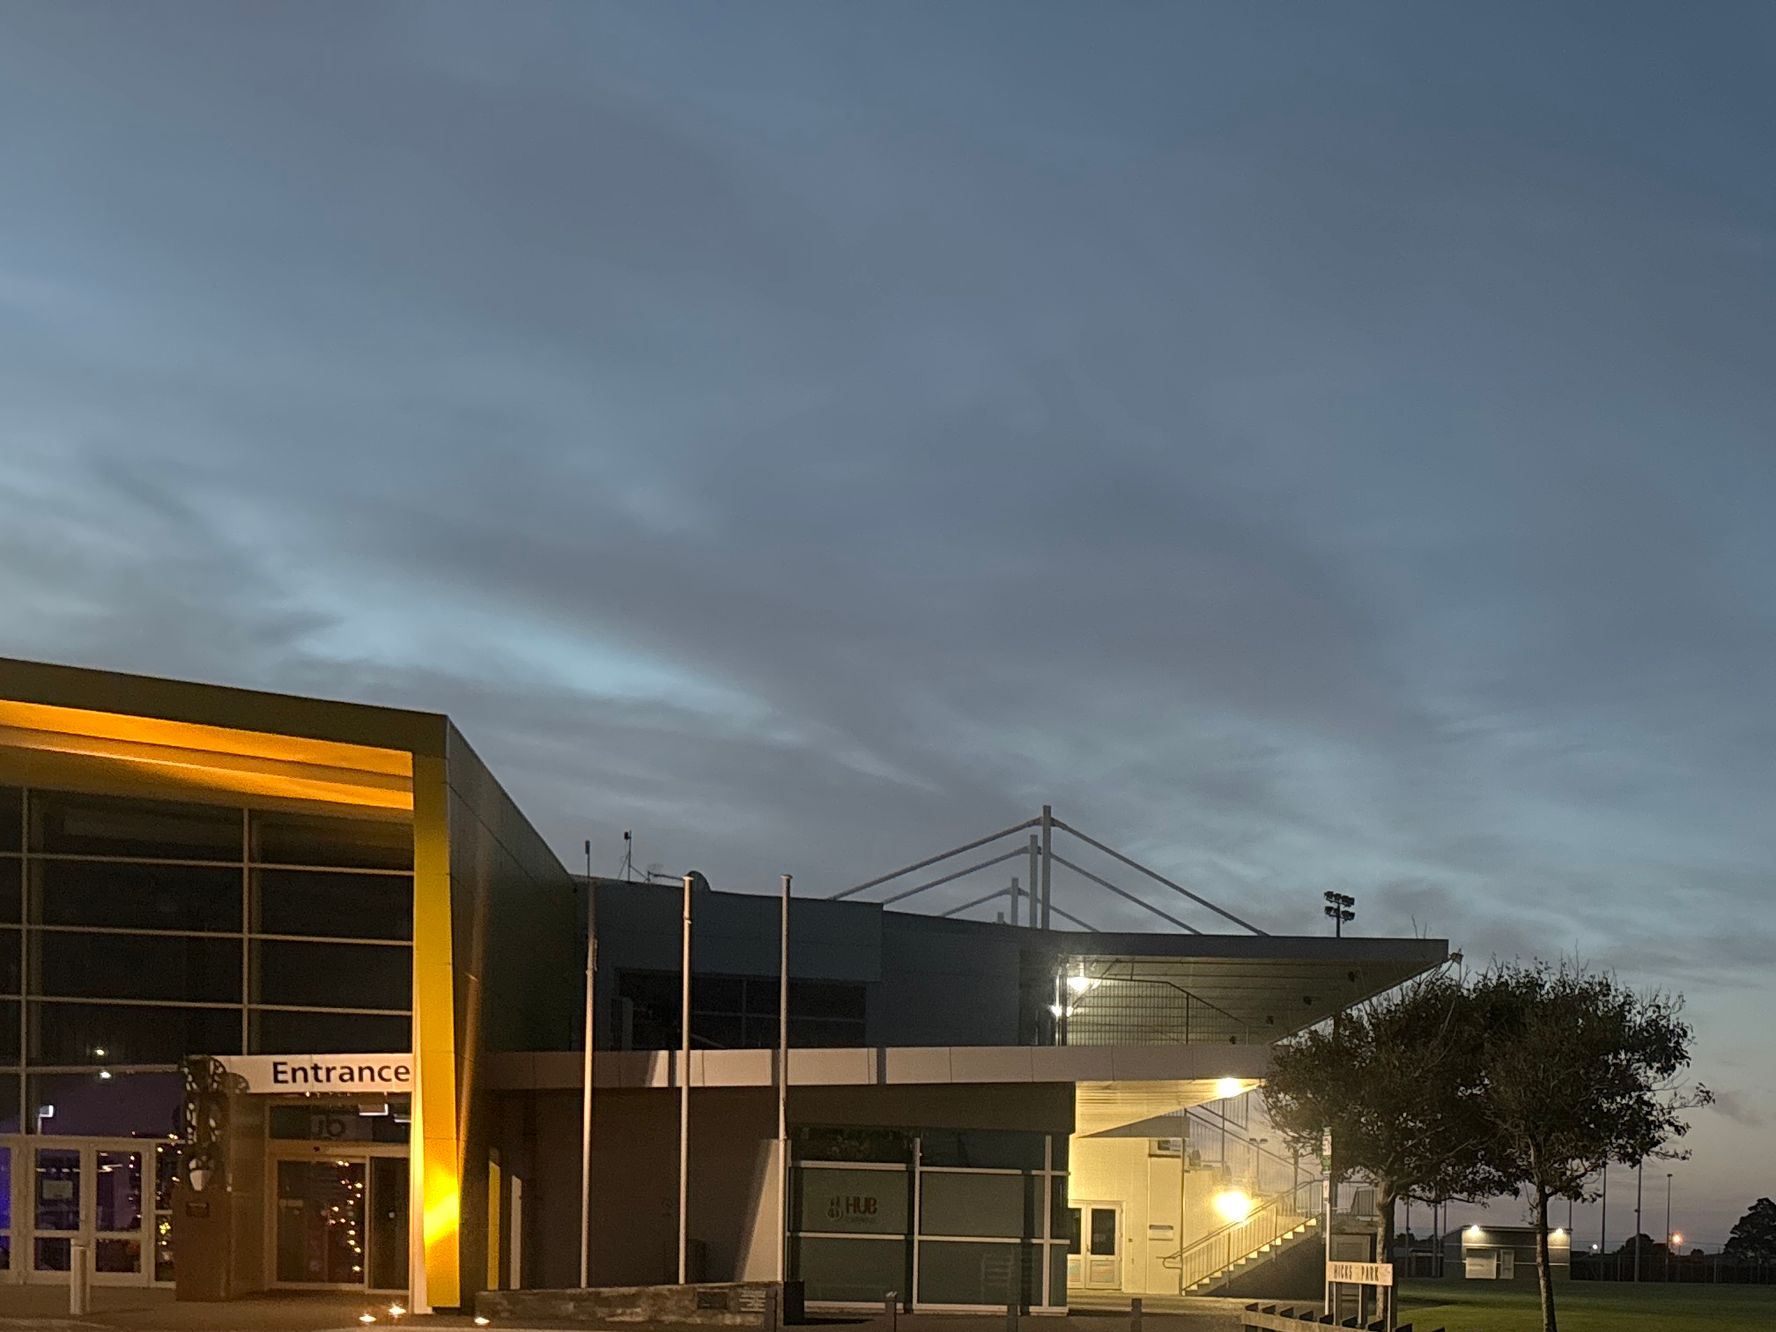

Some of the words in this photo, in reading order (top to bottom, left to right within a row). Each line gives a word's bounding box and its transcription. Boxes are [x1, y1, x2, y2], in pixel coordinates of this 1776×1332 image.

[272, 1062, 410, 1083] Entrance
[846, 1196, 877, 1214] HUB
[1361, 1266, 1379, 1281] PARK
